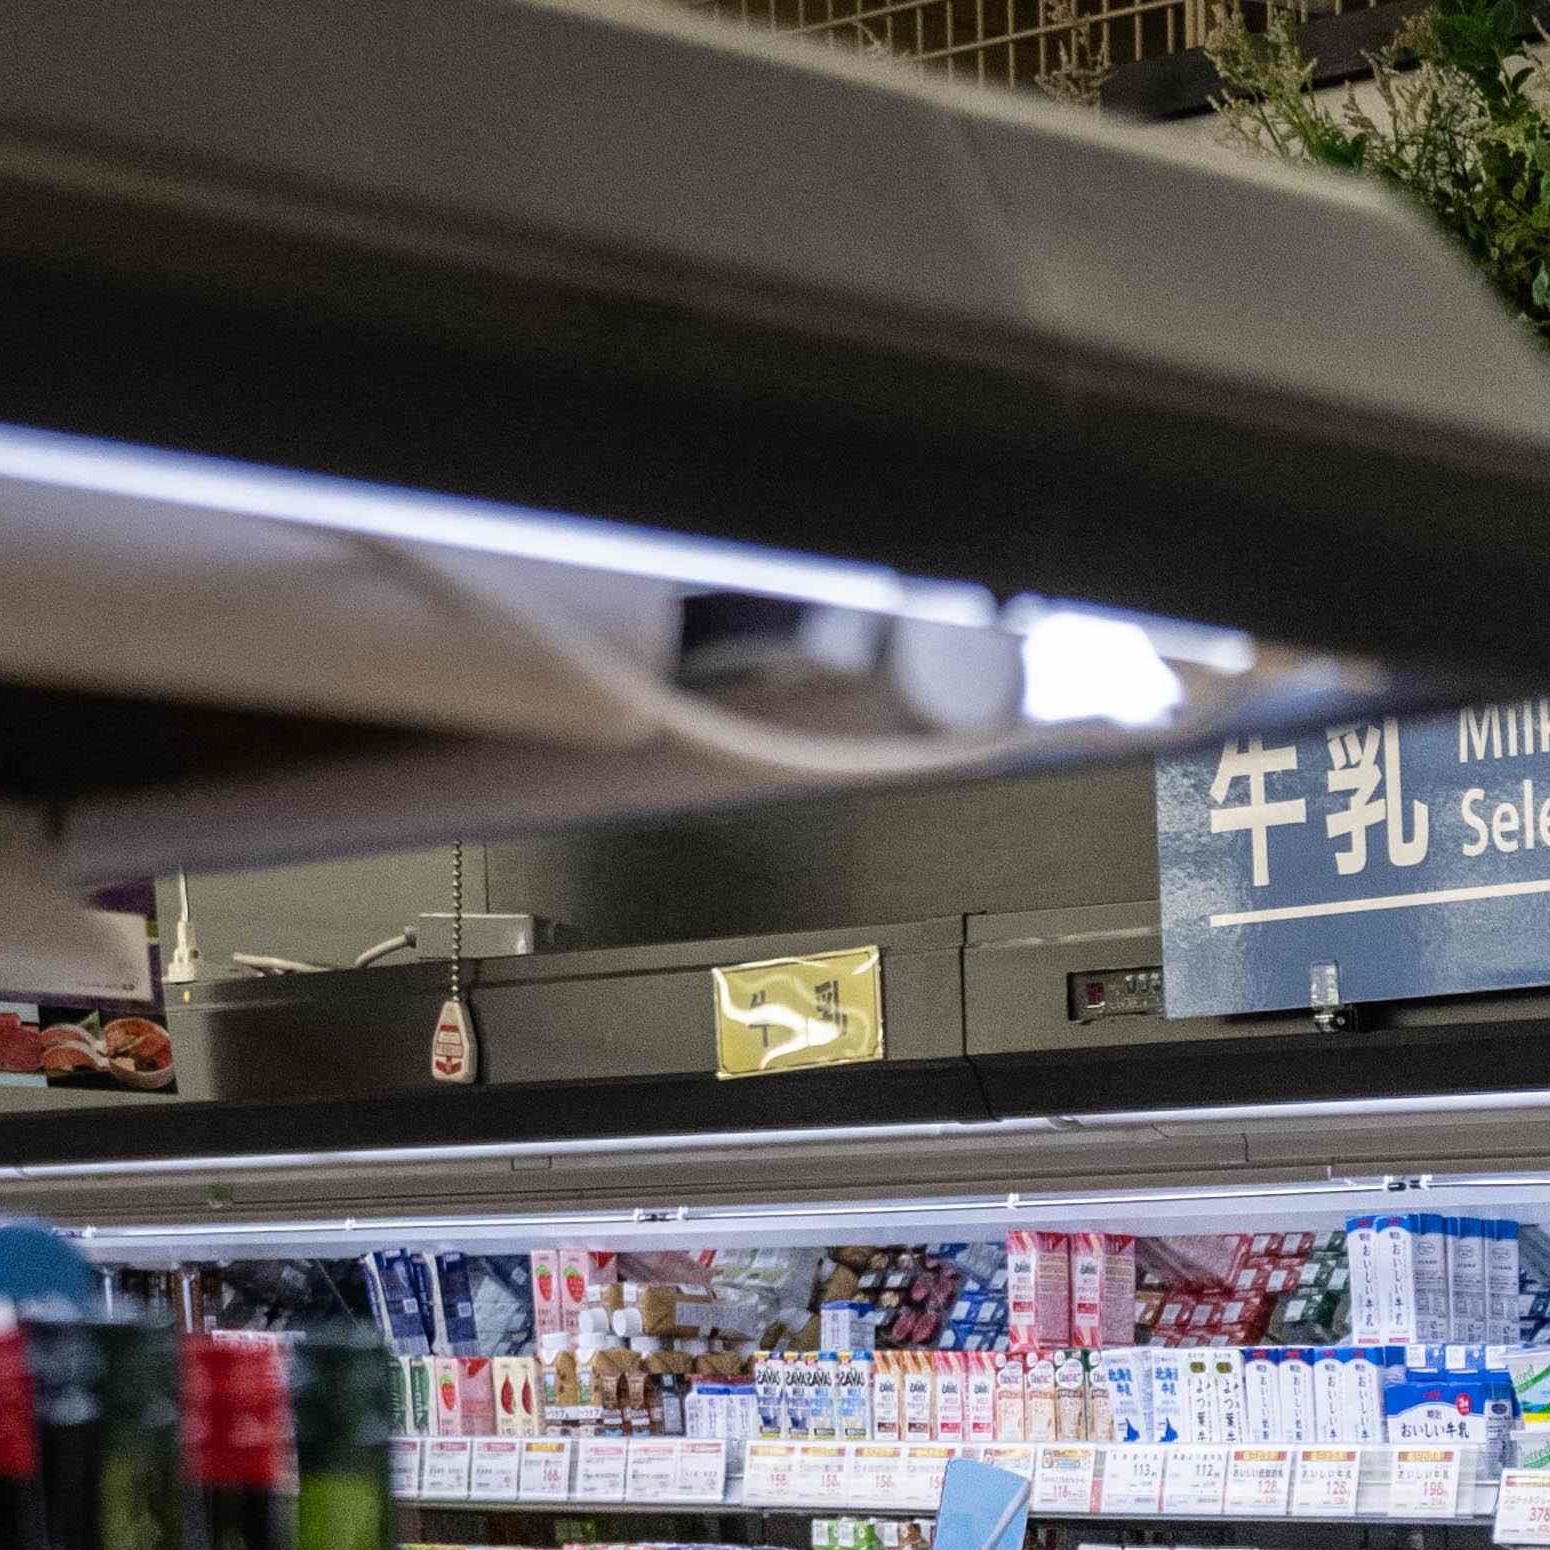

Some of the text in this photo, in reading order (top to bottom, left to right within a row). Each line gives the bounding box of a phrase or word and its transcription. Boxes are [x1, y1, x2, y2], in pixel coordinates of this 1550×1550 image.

[1400, 1422, 1471, 1441] おいしい牛乳
